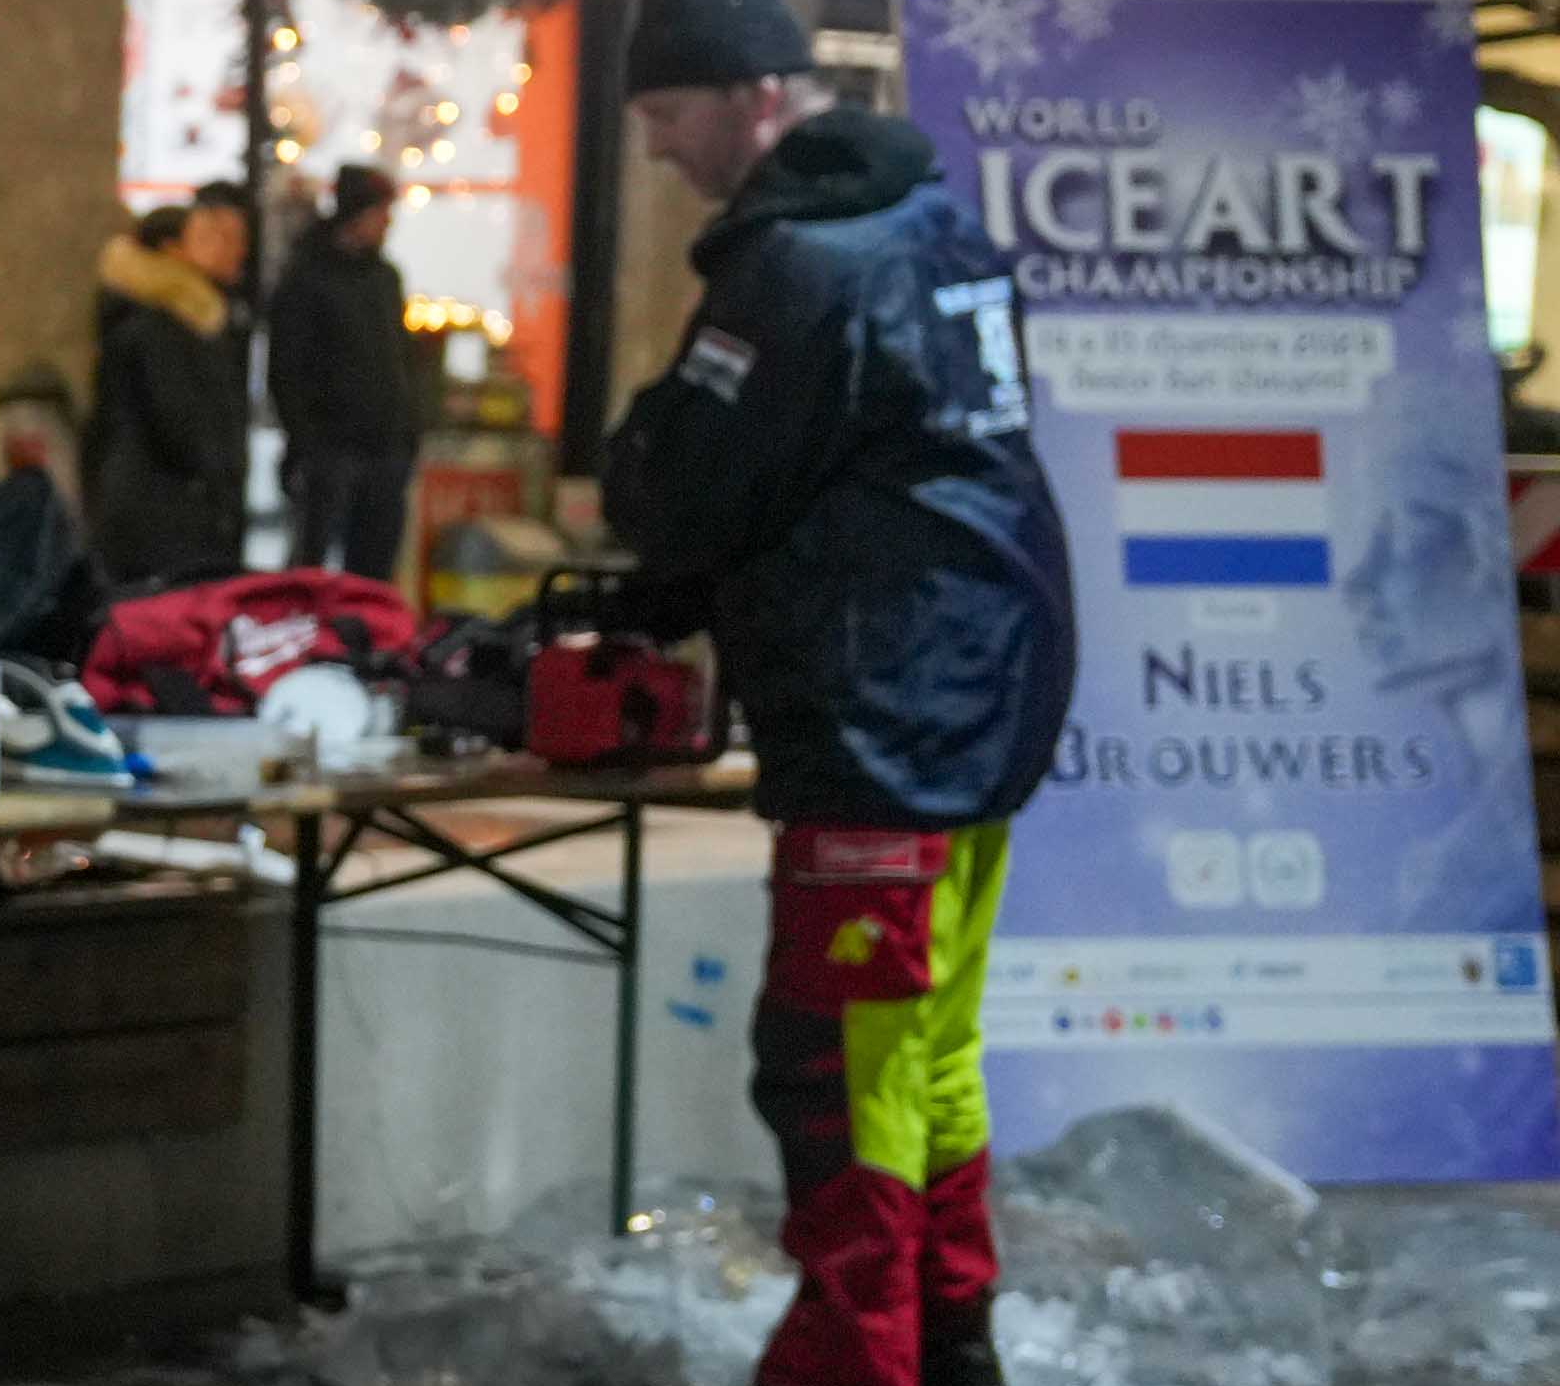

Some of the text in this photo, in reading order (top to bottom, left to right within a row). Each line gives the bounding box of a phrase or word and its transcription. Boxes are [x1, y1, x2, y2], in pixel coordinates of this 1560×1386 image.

[965, 95, 1161, 141] WORLD
[1015, 252, 1417, 301] CHAMPIONSHIP
[1141, 641, 1326, 711] NIELS
